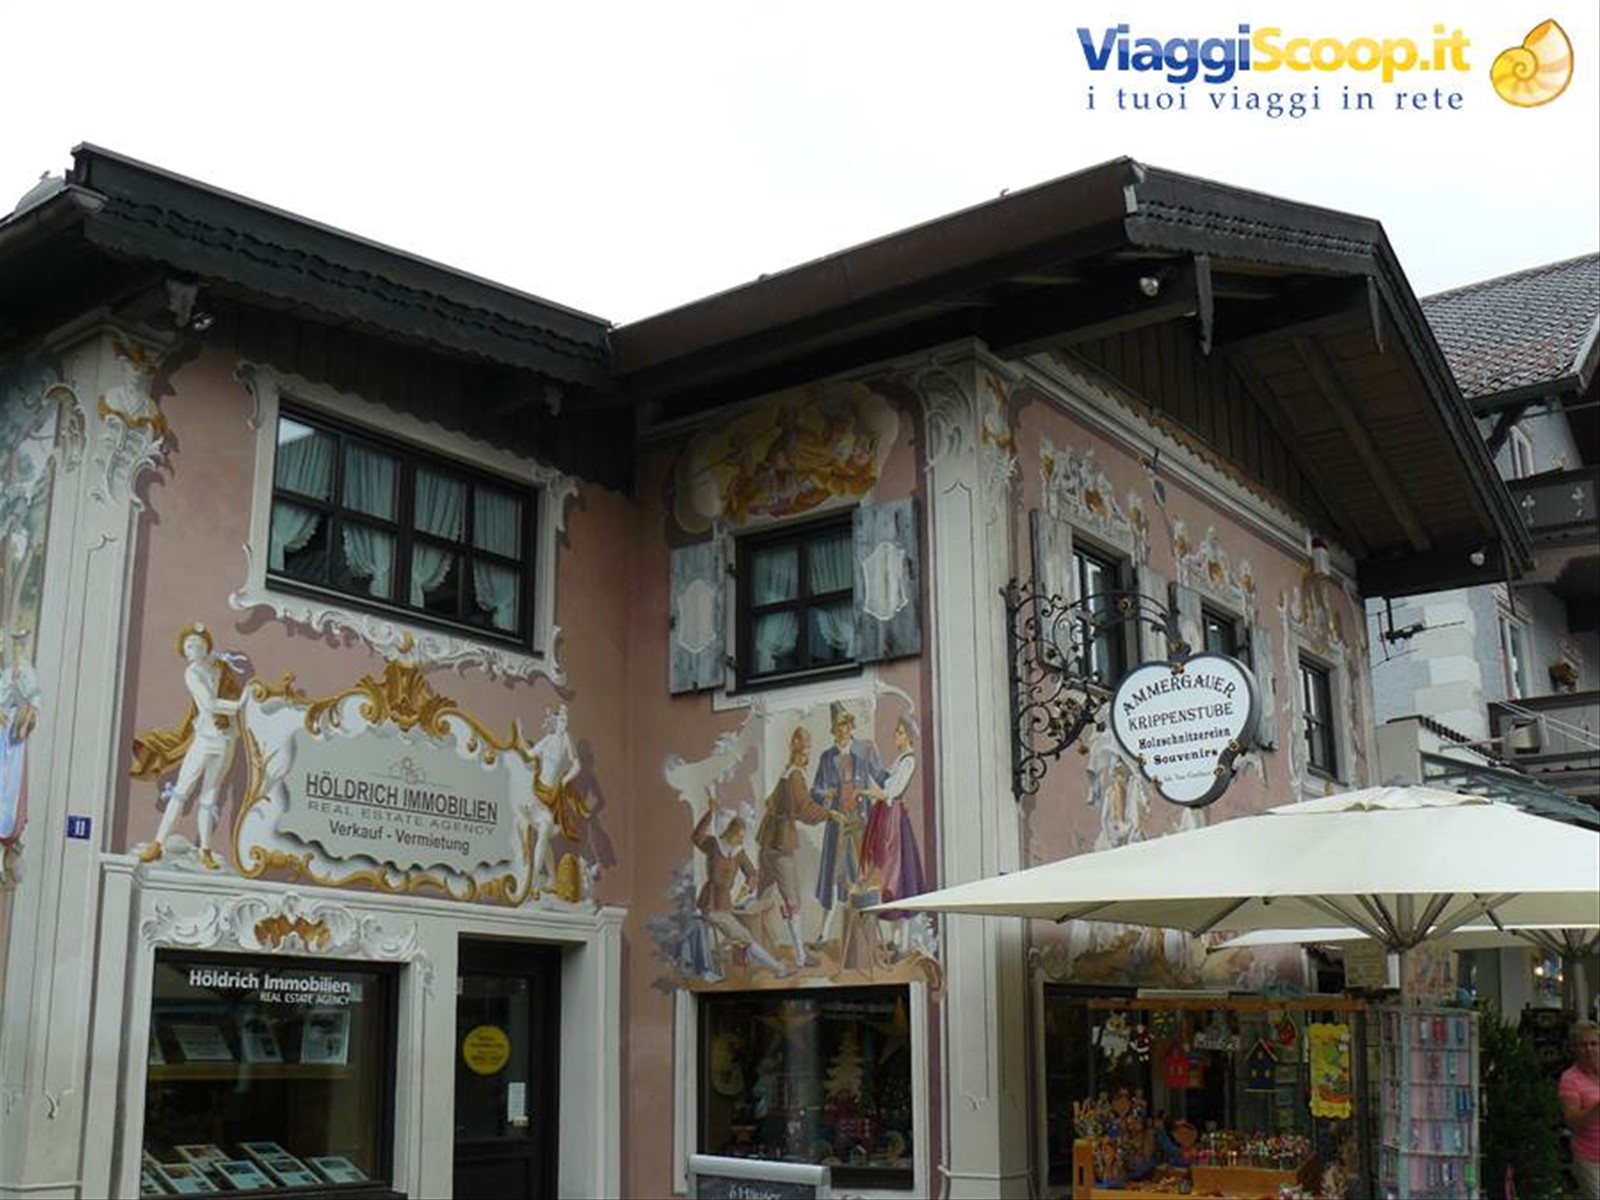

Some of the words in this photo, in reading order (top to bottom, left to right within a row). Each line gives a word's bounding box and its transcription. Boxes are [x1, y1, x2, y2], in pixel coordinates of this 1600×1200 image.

[1122, 674, 1236, 716] AMMERGAUER
[1128, 702, 1234, 732] KRIPPENSTUBE
[1138, 726, 1231, 750] Holzschnitzereien
[1153, 748, 1219, 765] Souvenirs
[306, 771, 398, 805] HÖLDRICH
[403, 790, 498, 821] IMMOBILIEN
[308, 801, 354, 816] REAL
[361, 808, 423, 827] ESTATE
[429, 818, 496, 836] AGENCY
[329, 820, 383, 840] Verkauf
[394, 829, 470, 855] Vermietung
[189, 969, 259, 989] Höldrich
[264, 974, 350, 993] Immobilien
[260, 991, 282, 1003] REAL
[284, 992, 313, 1004] ESTATE
[315, 994, 350, 1006] AGENCY
